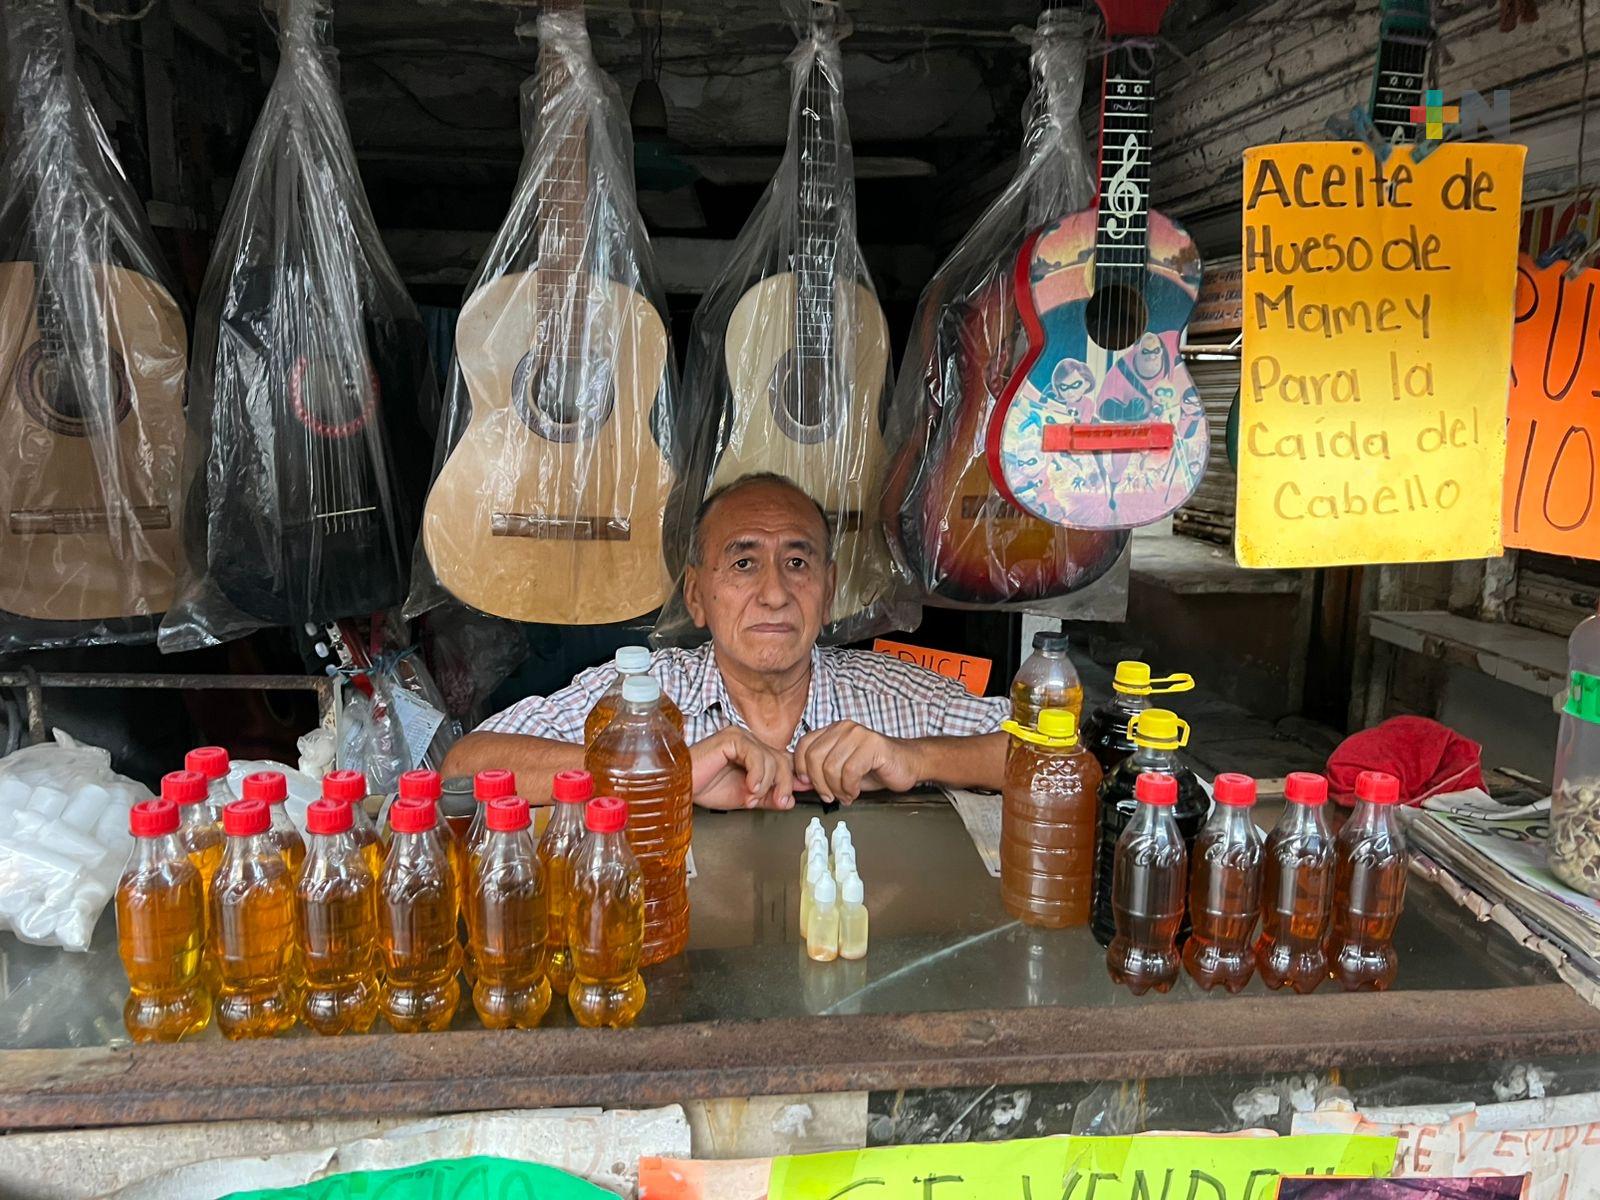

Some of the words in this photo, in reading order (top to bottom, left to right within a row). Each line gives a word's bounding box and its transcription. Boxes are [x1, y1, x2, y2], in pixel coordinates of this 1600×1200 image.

[1246, 158, 1413, 208] Aceite
[1441, 157, 1497, 211] de
[1246, 225, 1373, 275] Hueso
[1381, 224, 1451, 272] de
[1254, 284, 1431, 338] Mamey
[1250, 355, 1361, 405] Para
[1389, 351, 1434, 401] la
[1247, 416, 1391, 460] Caída
[1416, 406, 1479, 453] del
[1273, 474, 1461, 520] Cabello
